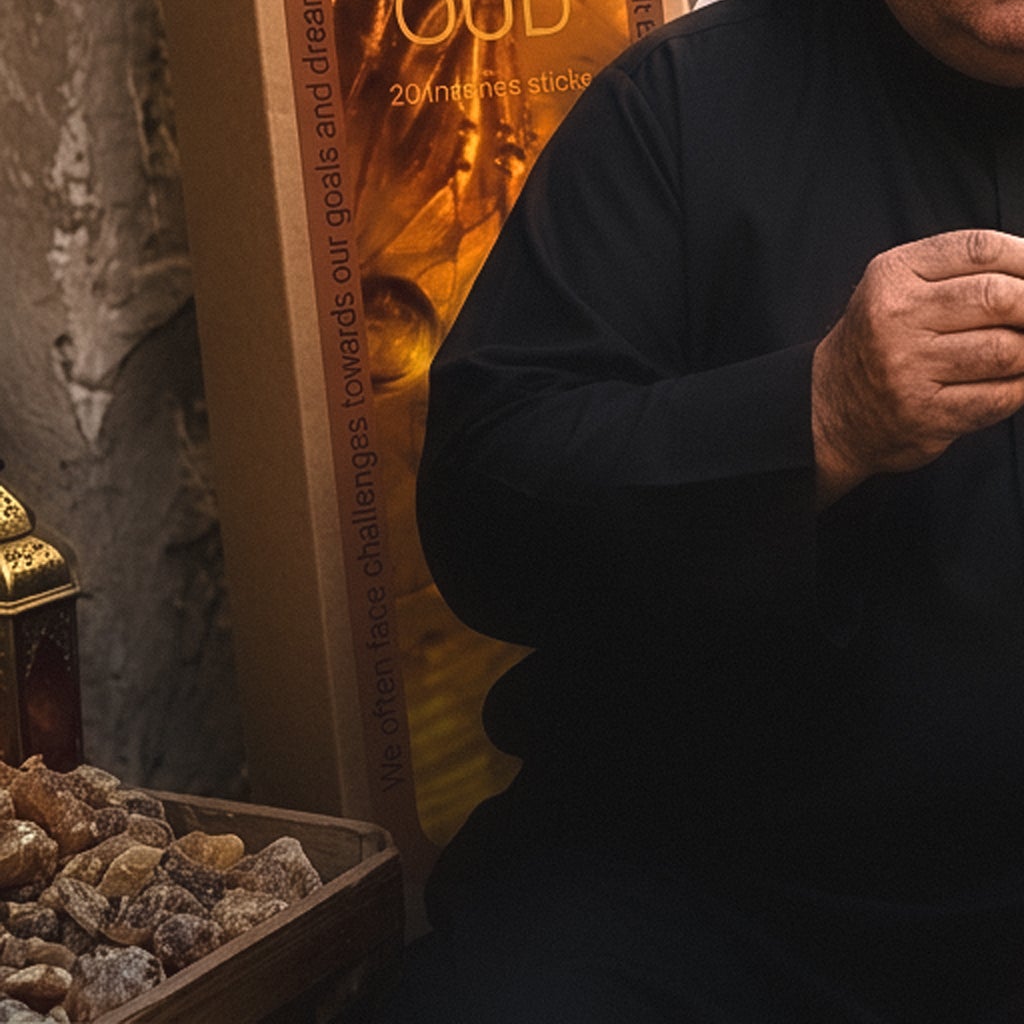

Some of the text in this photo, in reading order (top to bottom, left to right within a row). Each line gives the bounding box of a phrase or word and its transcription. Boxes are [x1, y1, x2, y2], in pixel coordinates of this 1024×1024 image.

[305, 82, 336, 139] and
[389, 83, 421, 107] 20
[315, 146, 350, 226] goals
[326, 237, 351, 284] our
[330, 292, 366, 409] towards
[349, 417, 385, 577] challenges
[366, 586, 391, 655] face
[372, 660, 398, 733] often
[381, 742, 406, 793] We
